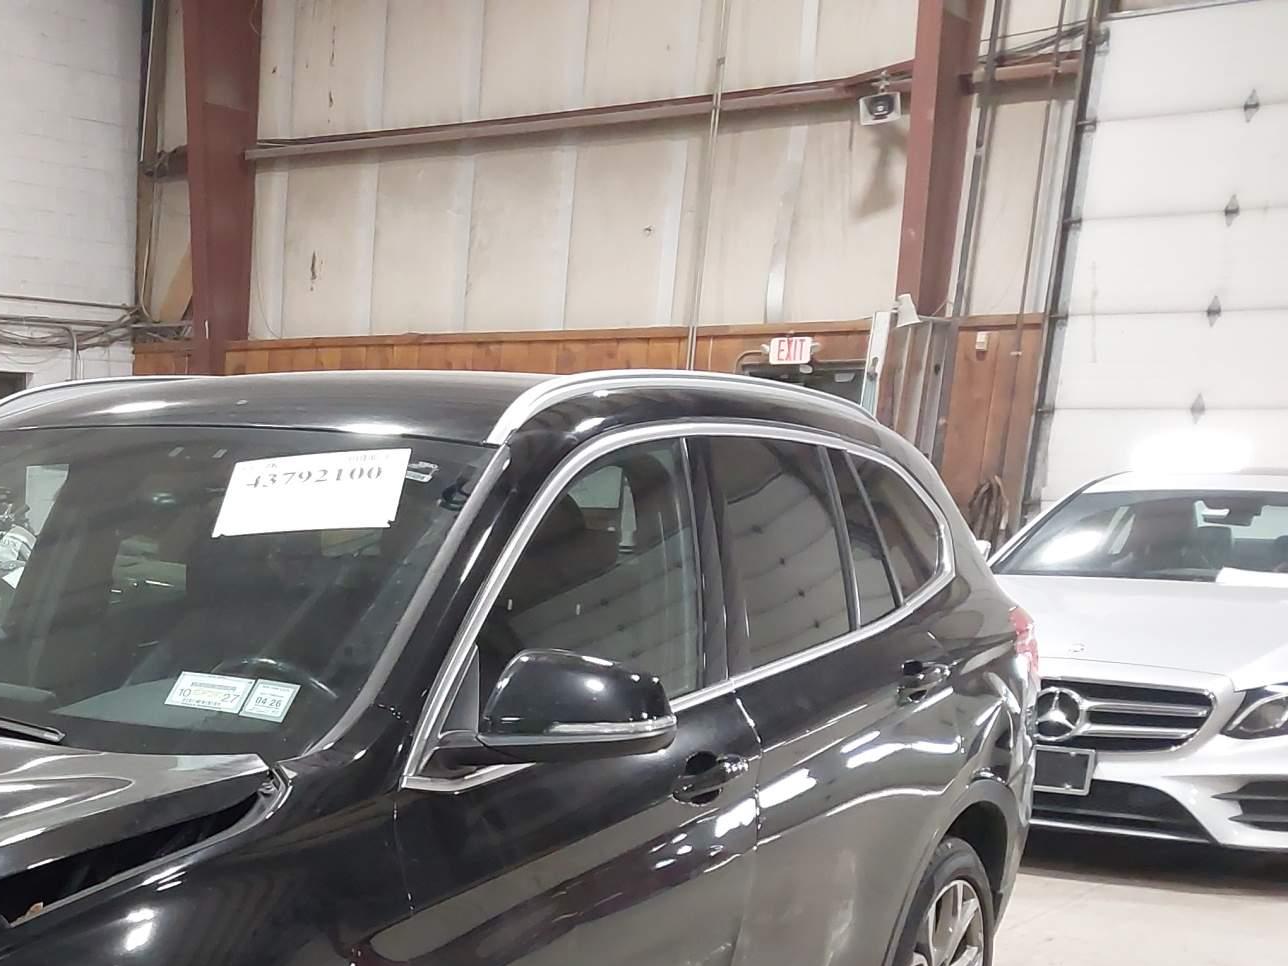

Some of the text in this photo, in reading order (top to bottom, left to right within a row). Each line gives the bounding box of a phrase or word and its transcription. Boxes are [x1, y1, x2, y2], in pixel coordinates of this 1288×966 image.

[777, 339, 806, 361] EXIT
[246, 466, 383, 489] 43792100
[178, 688, 192, 697] 10
[221, 693, 240, 703] 27
[270, 699, 282, 708] 26
